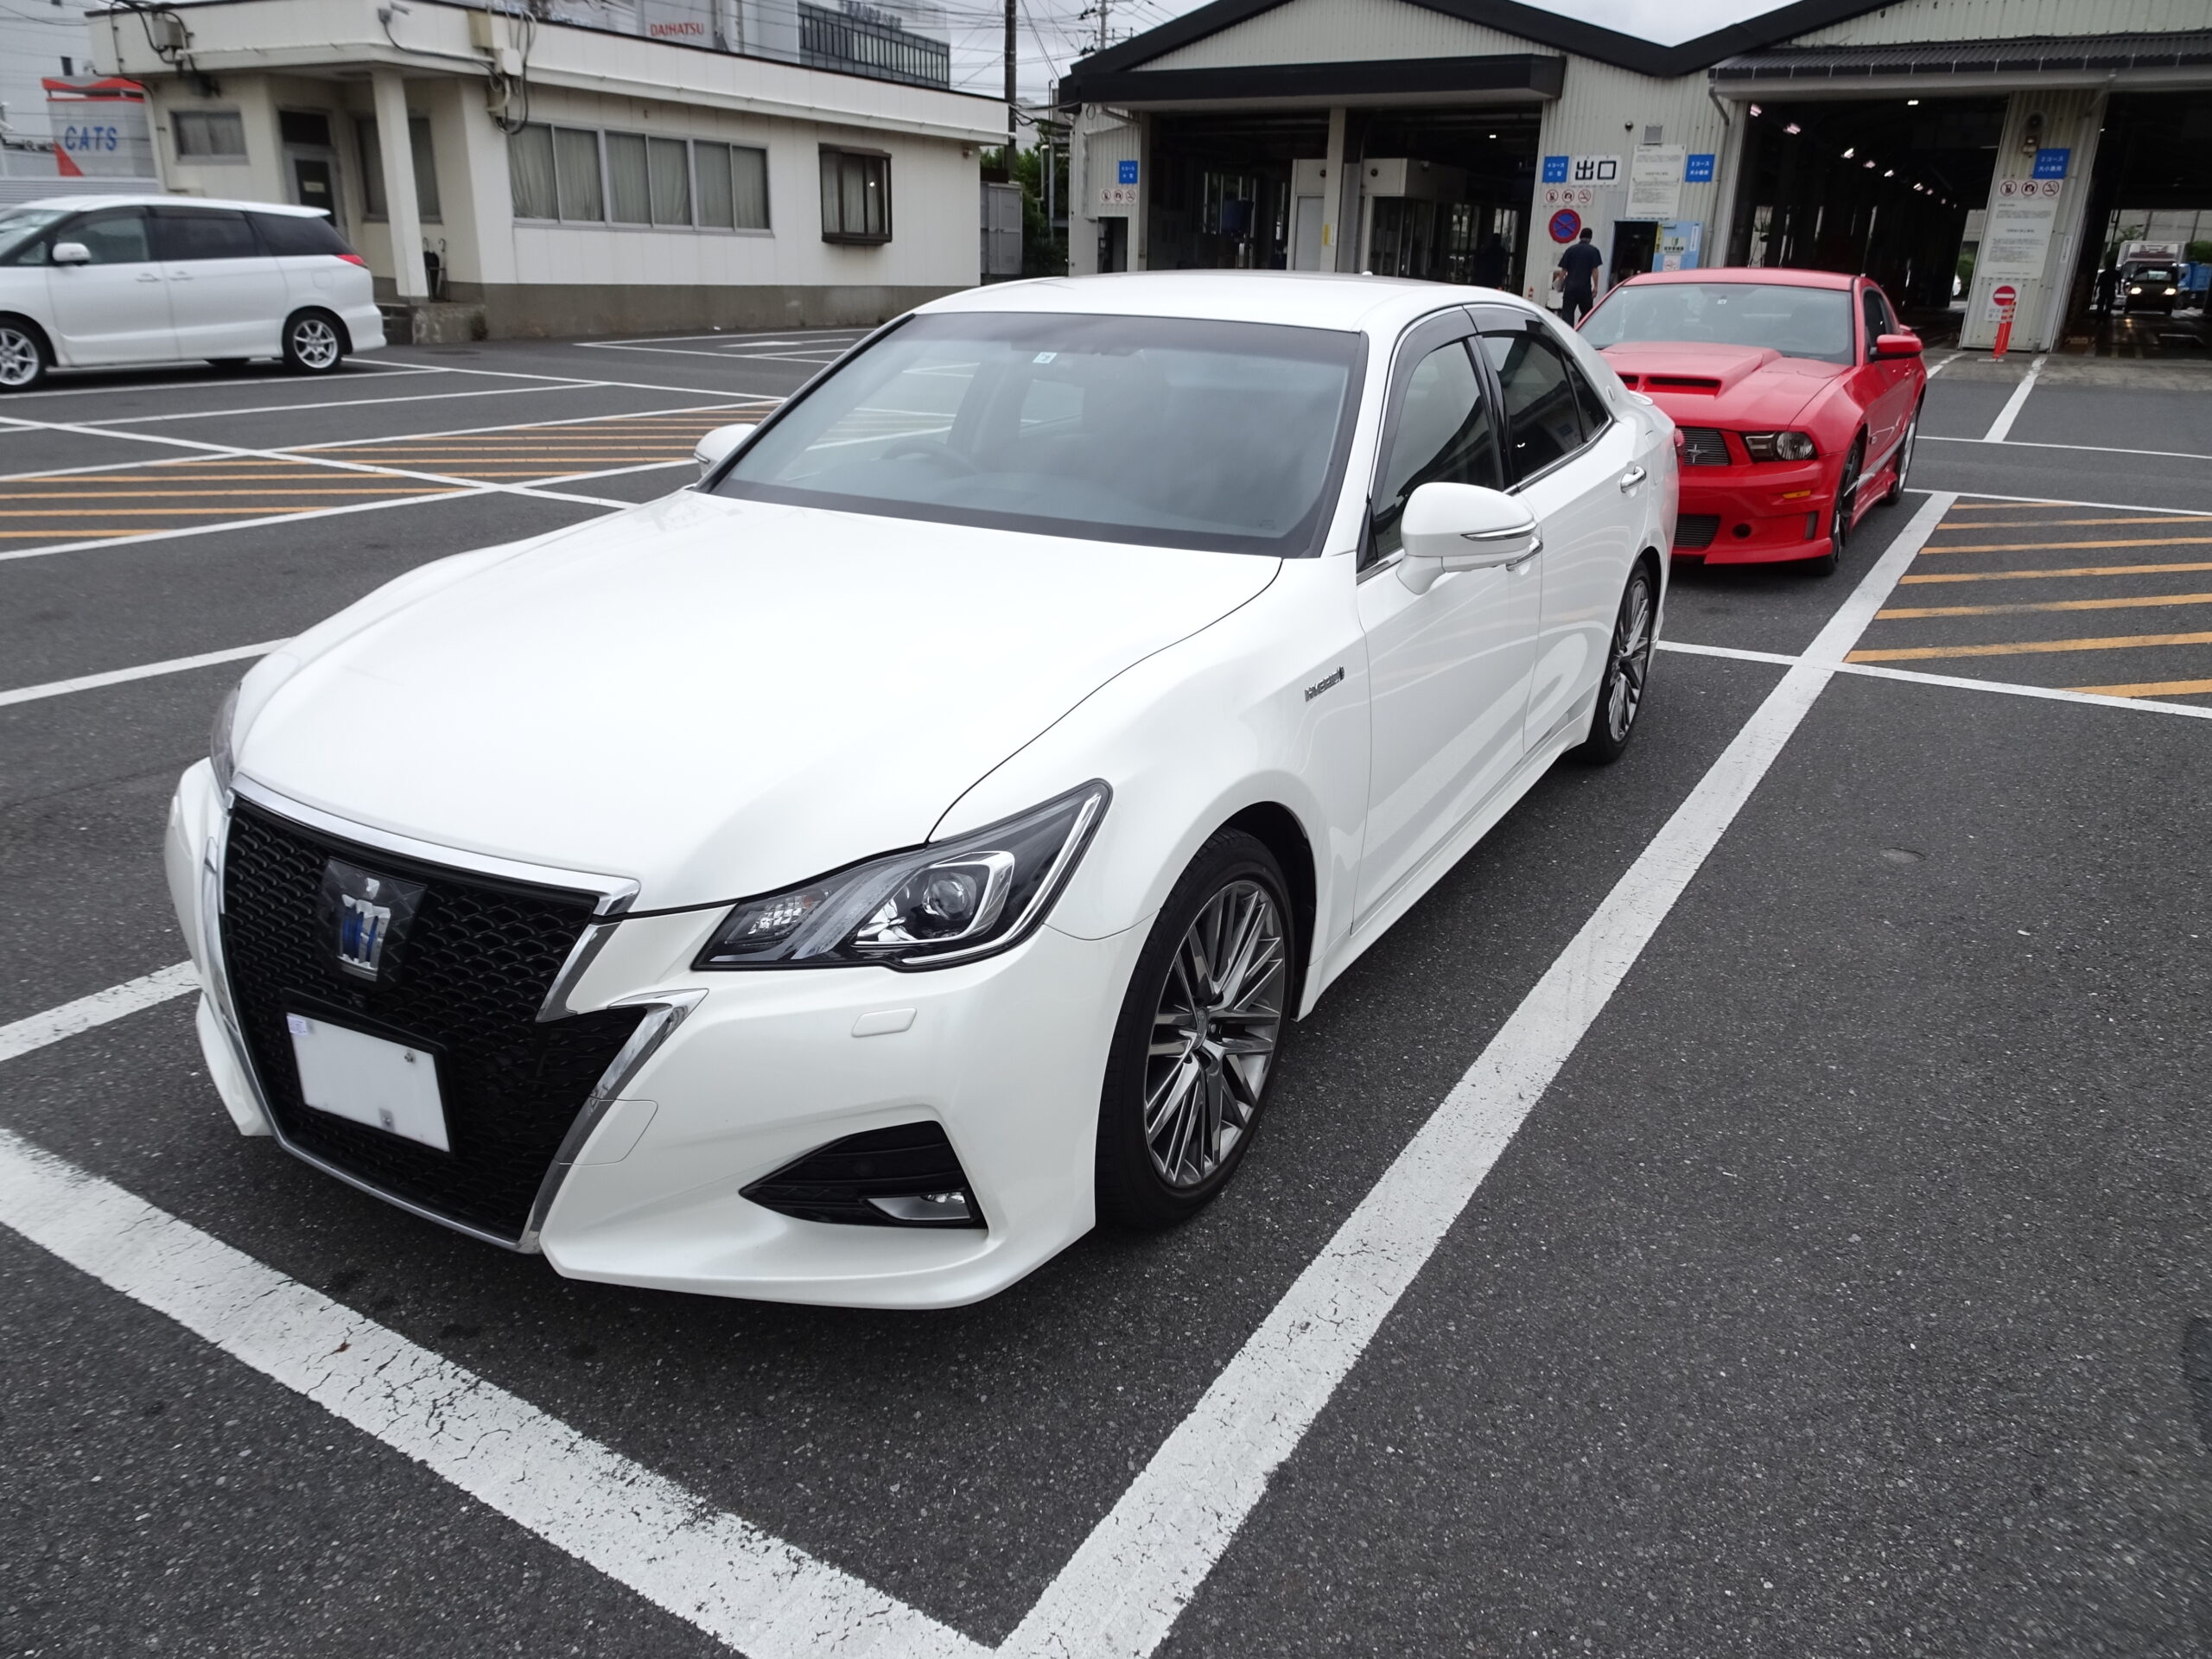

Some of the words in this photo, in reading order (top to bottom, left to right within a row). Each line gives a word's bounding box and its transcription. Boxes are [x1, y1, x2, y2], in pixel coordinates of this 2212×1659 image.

[650, 22, 705, 40] DAIHATSU
[65, 125, 118, 151] CATS
[1575, 159, 1617, 181] 出口
